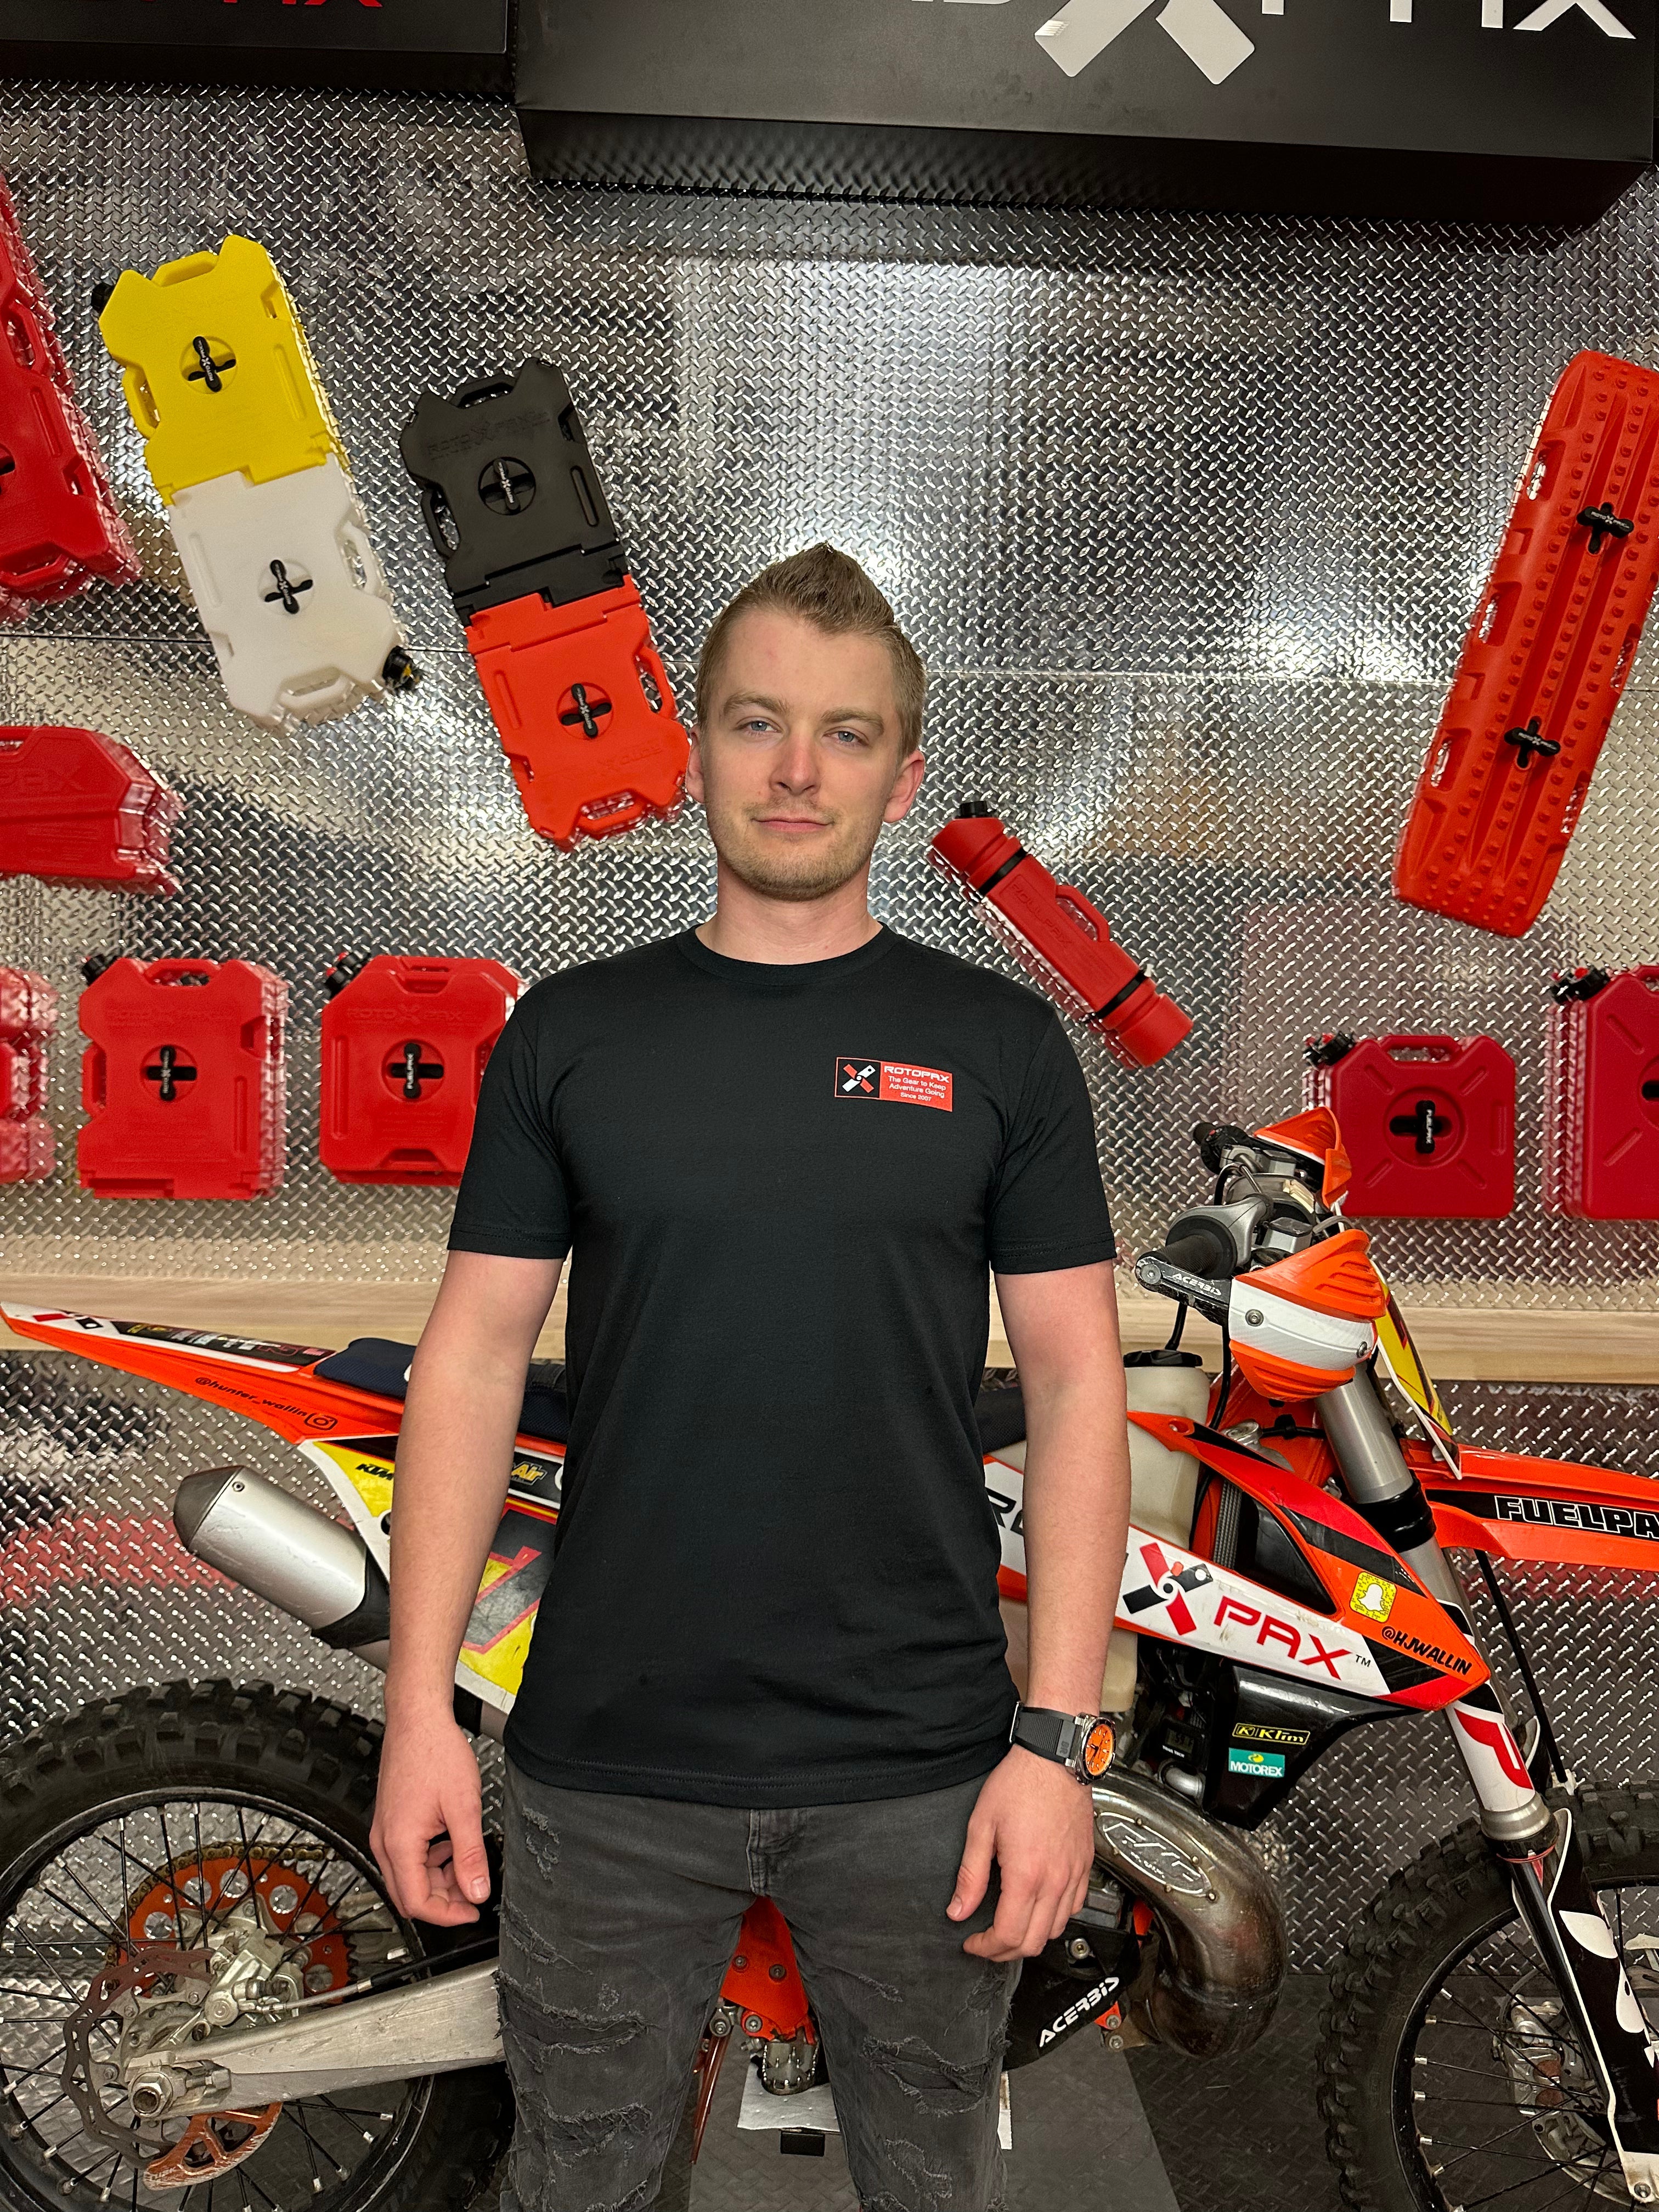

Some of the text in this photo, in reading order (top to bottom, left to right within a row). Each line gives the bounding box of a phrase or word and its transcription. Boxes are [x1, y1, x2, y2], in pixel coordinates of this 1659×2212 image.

[884, 1065, 950, 1084] ROTOPAX
[889, 1082, 945, 1098] Adventure Going
[929, 1082, 946, 1091] Keep
[195, 1376, 307, 1417] @hunter_wallin
[355, 1463, 394, 1481] KTM
[511, 1464, 544, 1482] Air
[1214, 1595, 1353, 1680] PAX
[1381, 1626, 1472, 1676] @HJWALLIN
[1230, 1760, 1283, 1777] MOTOREX
